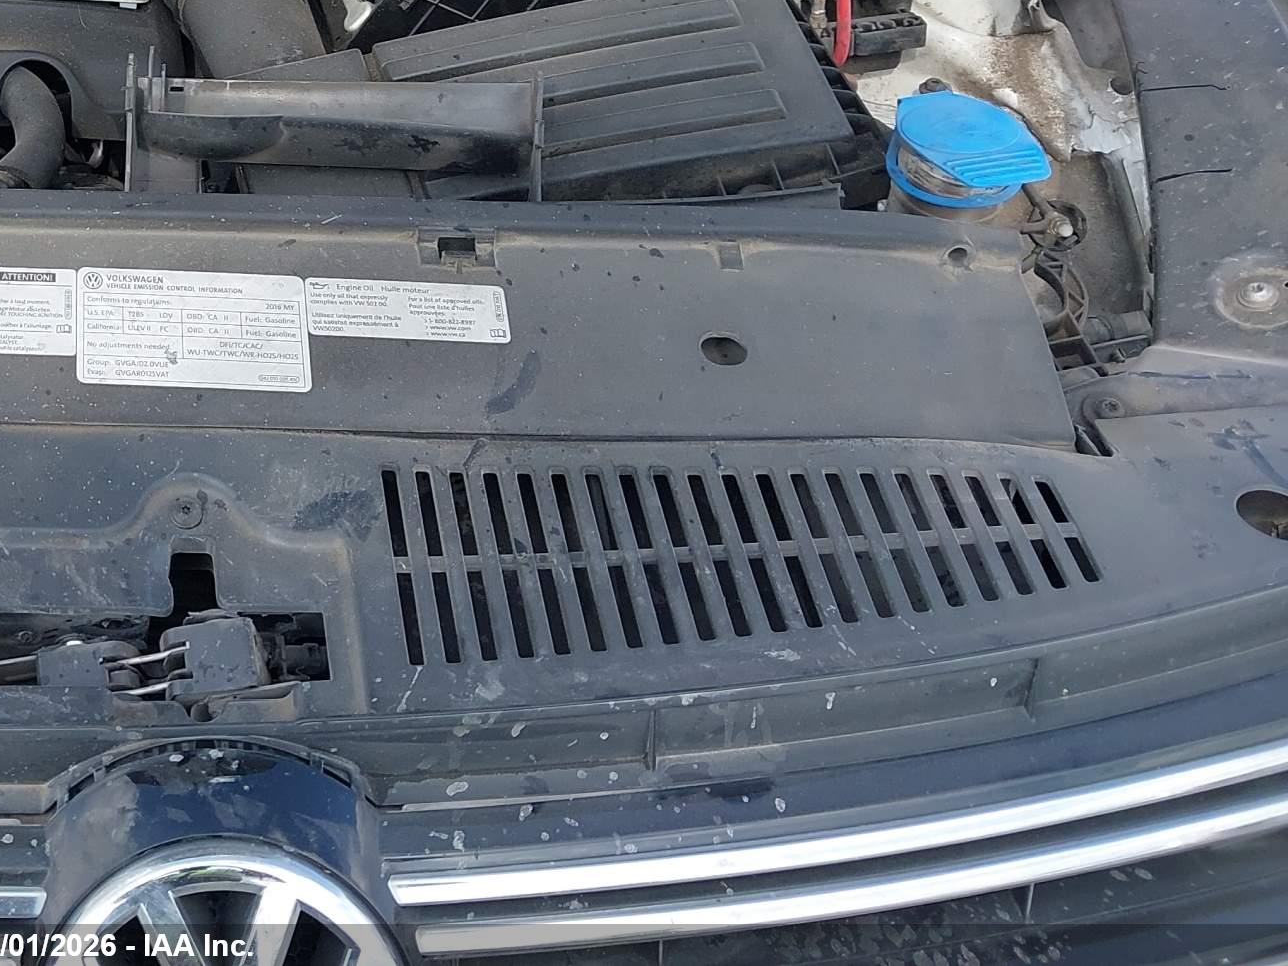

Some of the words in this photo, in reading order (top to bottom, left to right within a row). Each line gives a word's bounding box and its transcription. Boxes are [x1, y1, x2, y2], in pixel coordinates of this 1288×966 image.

[2, 273, 53, 282] ATTENTION!
[107, 274, 163, 283] VOLKSWAGEN
[336, 284, 361, 292] Engine
[99, 341, 142, 349] adjustments
